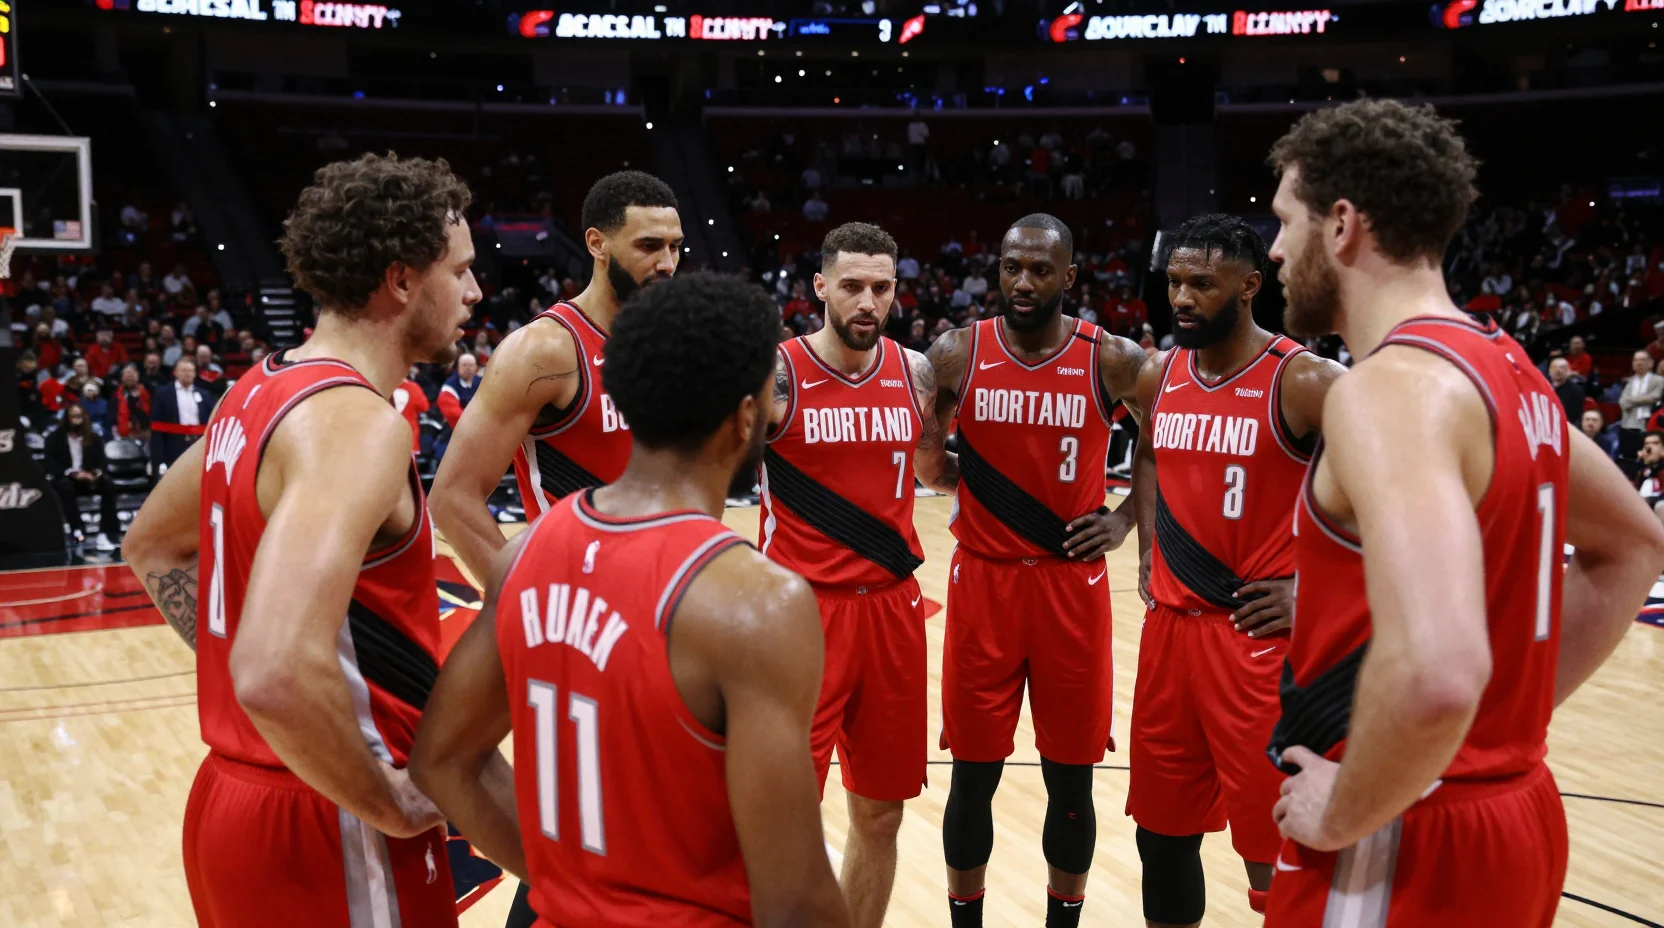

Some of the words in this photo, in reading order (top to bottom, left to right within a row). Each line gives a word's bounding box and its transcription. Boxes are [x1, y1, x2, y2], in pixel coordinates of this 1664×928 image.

[600, 394, 630, 433] B
[891, 450, 908, 499] 7
[1058, 434, 1080, 484] 3
[1534, 482, 1555, 641] 1
[527, 678, 607, 857] 11
